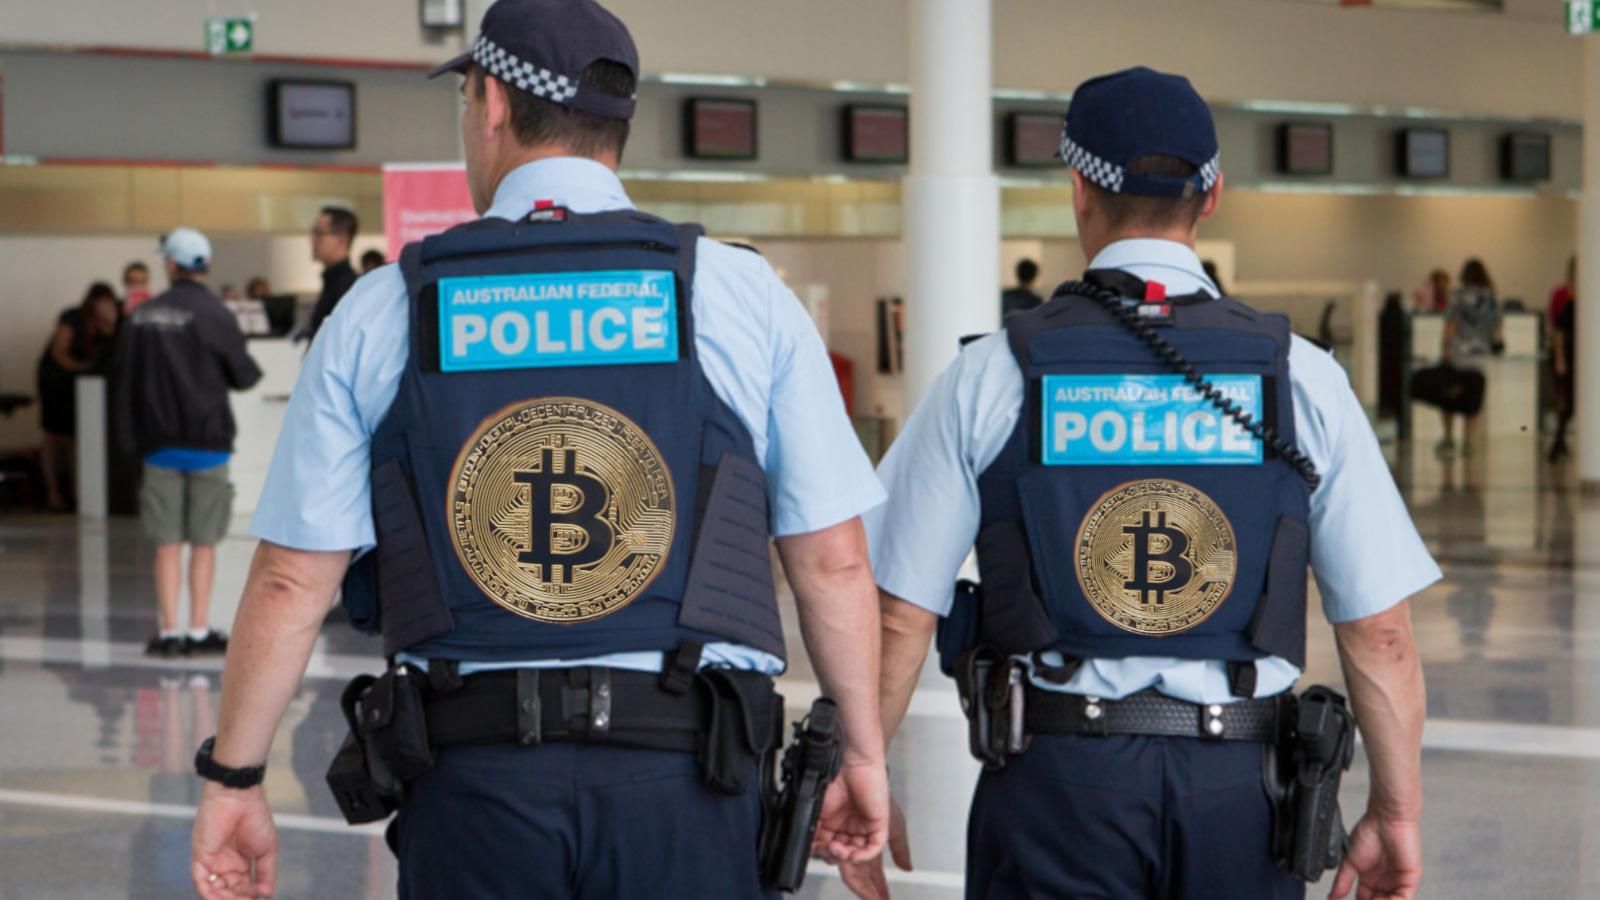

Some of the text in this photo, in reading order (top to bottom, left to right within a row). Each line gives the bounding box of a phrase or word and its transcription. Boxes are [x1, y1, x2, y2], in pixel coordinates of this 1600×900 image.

[452, 281, 663, 304] AUSTRALIAN FEDERAL
[452, 307, 666, 357] POLICE
[1054, 410, 1252, 452] POLICE
